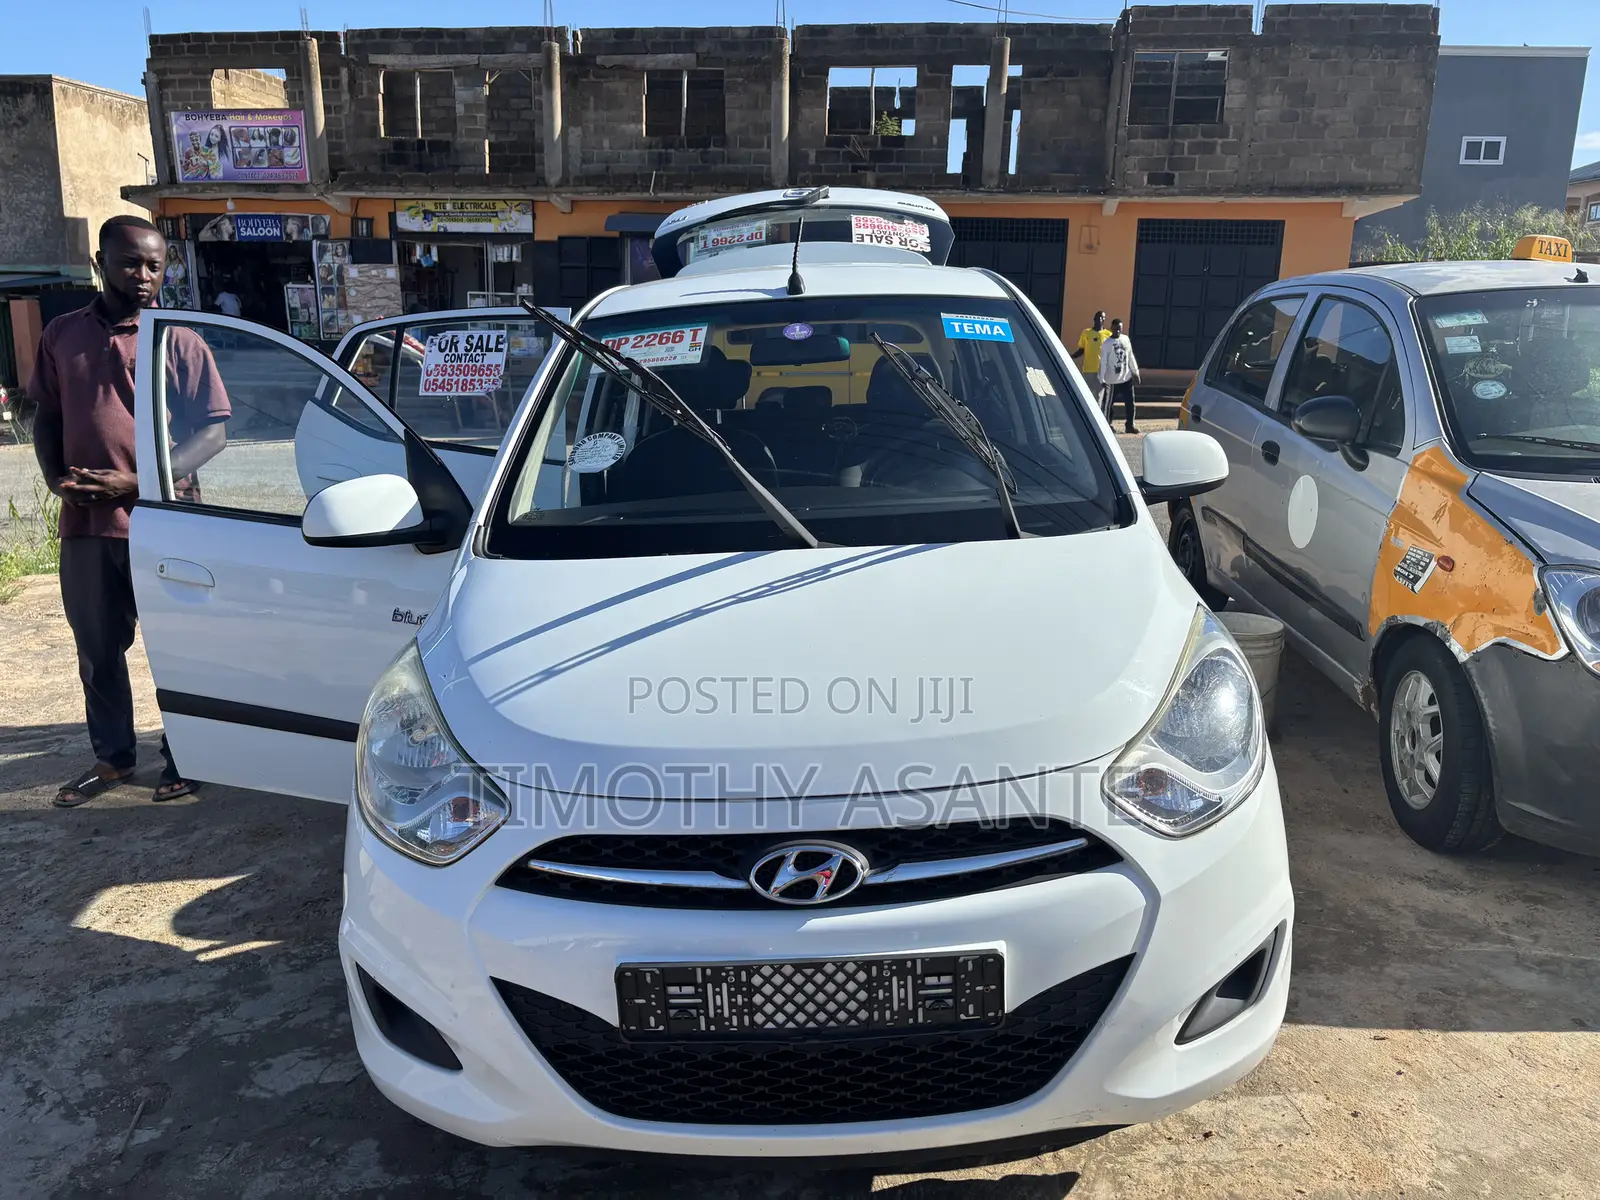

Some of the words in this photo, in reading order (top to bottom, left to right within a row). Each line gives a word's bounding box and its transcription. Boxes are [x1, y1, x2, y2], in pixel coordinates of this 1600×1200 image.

[185, 113, 227, 121] BOHYEBA
[453, 202, 496, 210] ELECTRICALS
[237, 218, 280, 228] BOHYEBA
[240, 227, 281, 237] SALOON
[746, 231, 763, 241] DP
[871, 229, 911, 238] ONTACT
[712, 234, 745, 247] 2266
[855, 233, 894, 245] SALE
[1538, 239, 1569, 258] TAXI
[950, 322, 1006, 336] TEMA
[464, 334, 504, 353] SALE
[604, 336, 630, 351] DP
[630, 330, 685, 349] 2266
[689, 328, 703, 342] T
[443, 353, 487, 364] CONTACT
[425, 363, 501, 378] 0593509655
[587, 433, 620, 442] COMPANY
[612, 439, 625, 461] LIMITED
